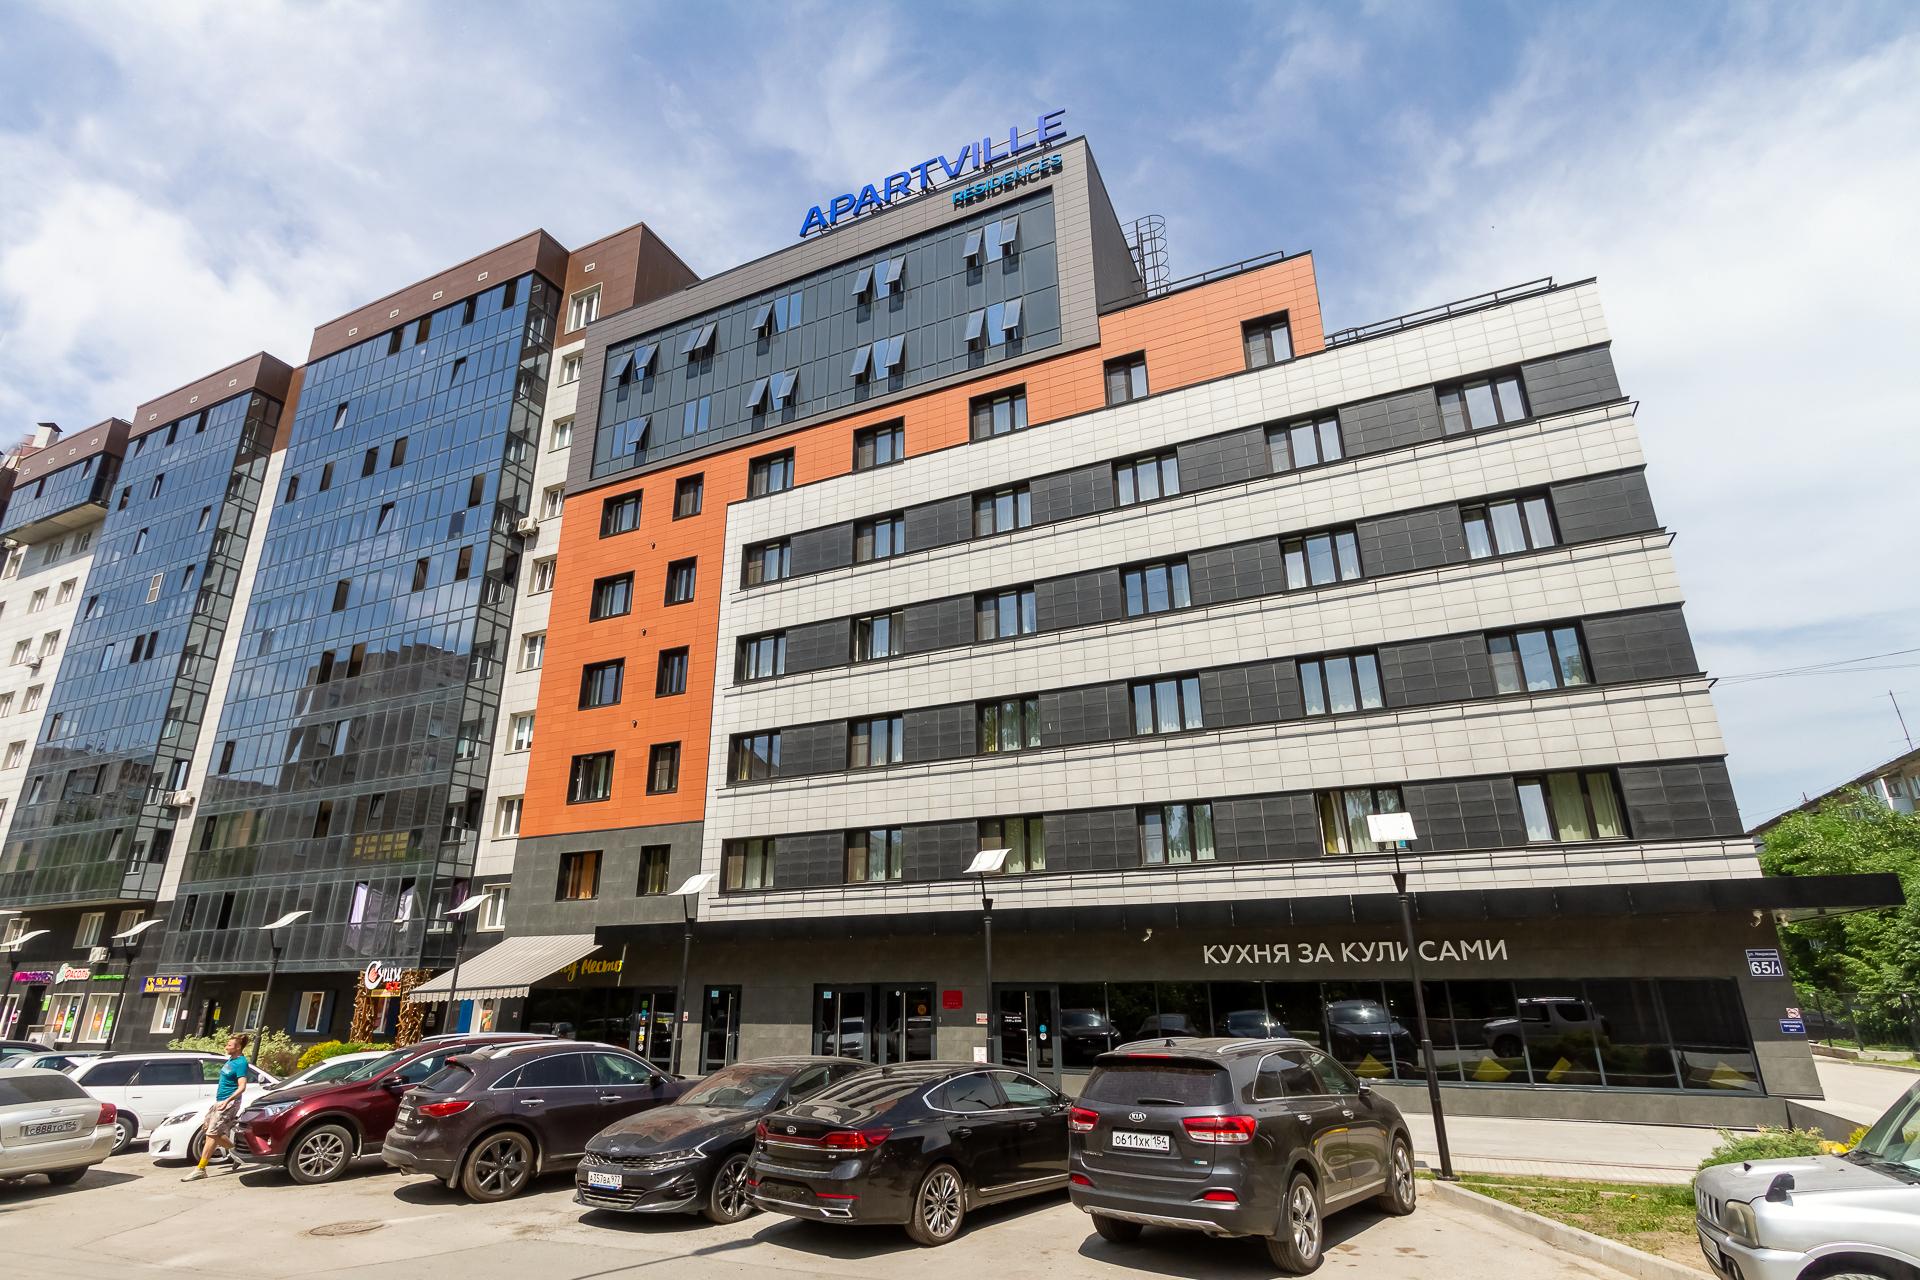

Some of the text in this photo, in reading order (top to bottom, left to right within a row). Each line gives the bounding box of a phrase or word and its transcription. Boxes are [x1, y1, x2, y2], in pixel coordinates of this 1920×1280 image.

[800, 108, 1067, 237] APARTVILLE
[952, 154, 1062, 204] RESIDENCES
[1203, 943, 1290, 964] КУХНЯ
[1298, 943, 1335, 963] ЗА
[1751, 961, 1781, 974] 65/1
